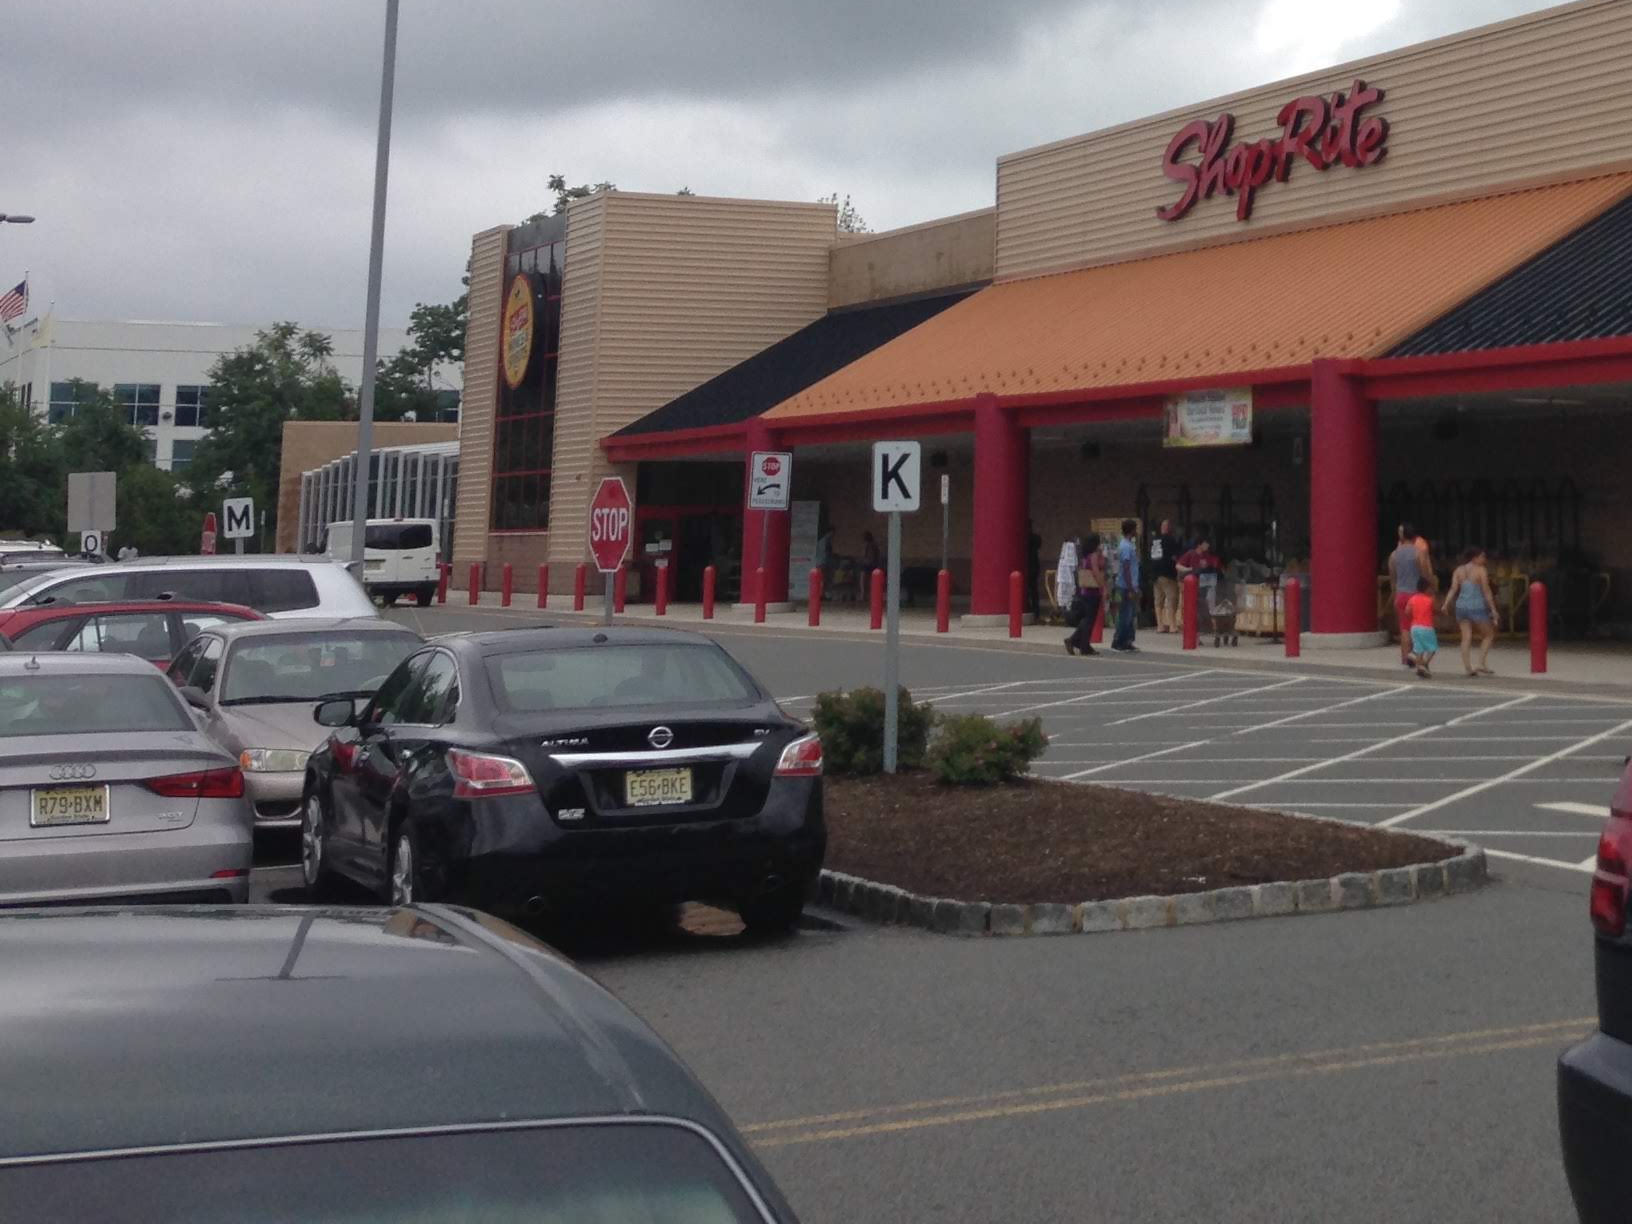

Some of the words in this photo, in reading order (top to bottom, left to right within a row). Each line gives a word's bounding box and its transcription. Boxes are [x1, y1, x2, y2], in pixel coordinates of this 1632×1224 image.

[1157, 79, 1389, 222] ShopRite
[762, 462, 780, 471] STOP
[881, 453, 912, 500] K
[226, 504, 250, 532] M
[592, 507, 628, 542] STOP
